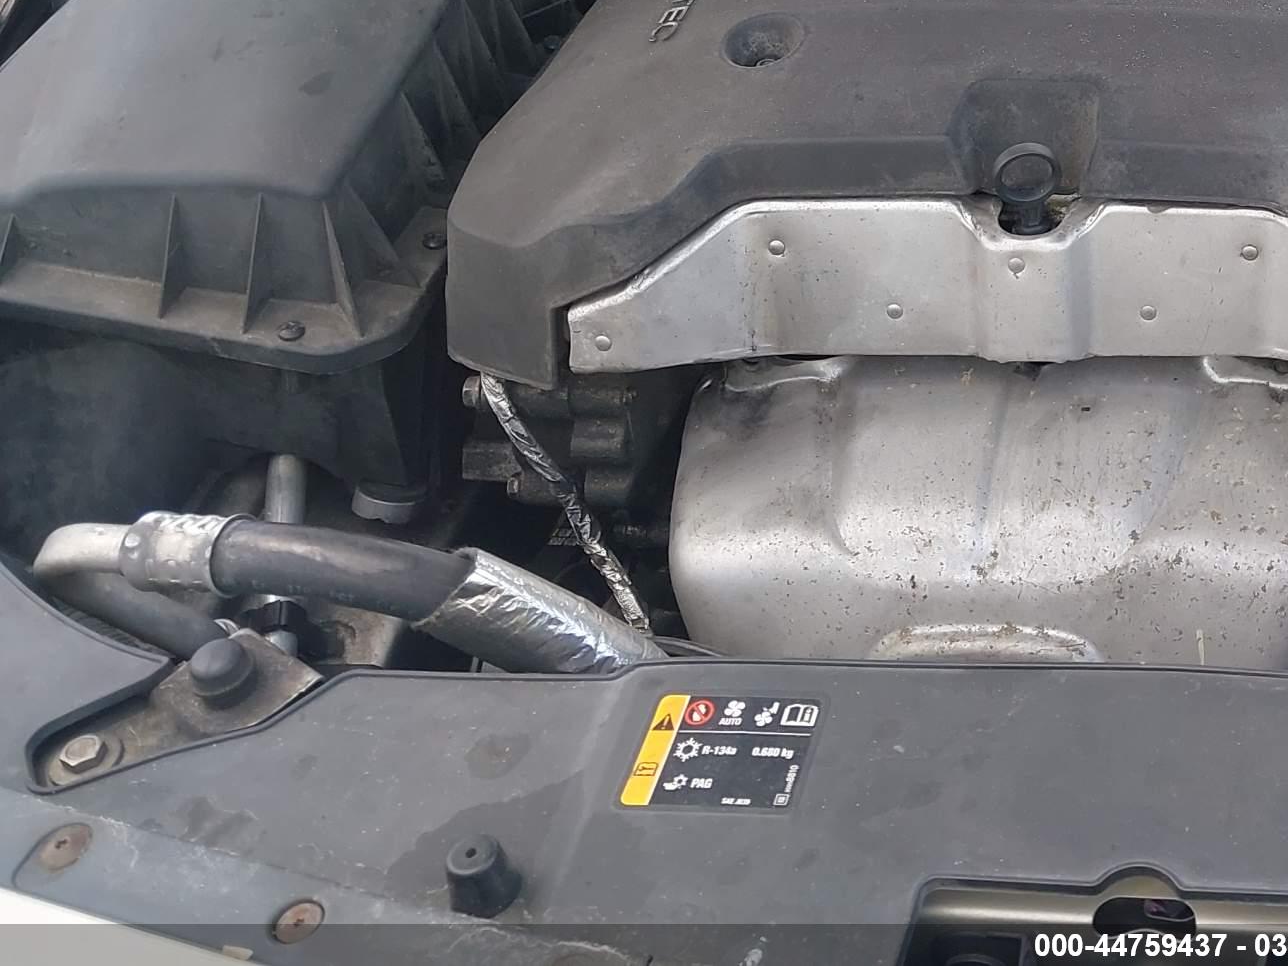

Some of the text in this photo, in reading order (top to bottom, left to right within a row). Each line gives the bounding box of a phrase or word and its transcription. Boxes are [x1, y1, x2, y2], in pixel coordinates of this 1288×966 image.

[718, 717, 743, 726] AUTO
[701, 745, 738, 756] R-134a
[780, 747, 795, 760] kg
[690, 778, 713, 789] PAG
